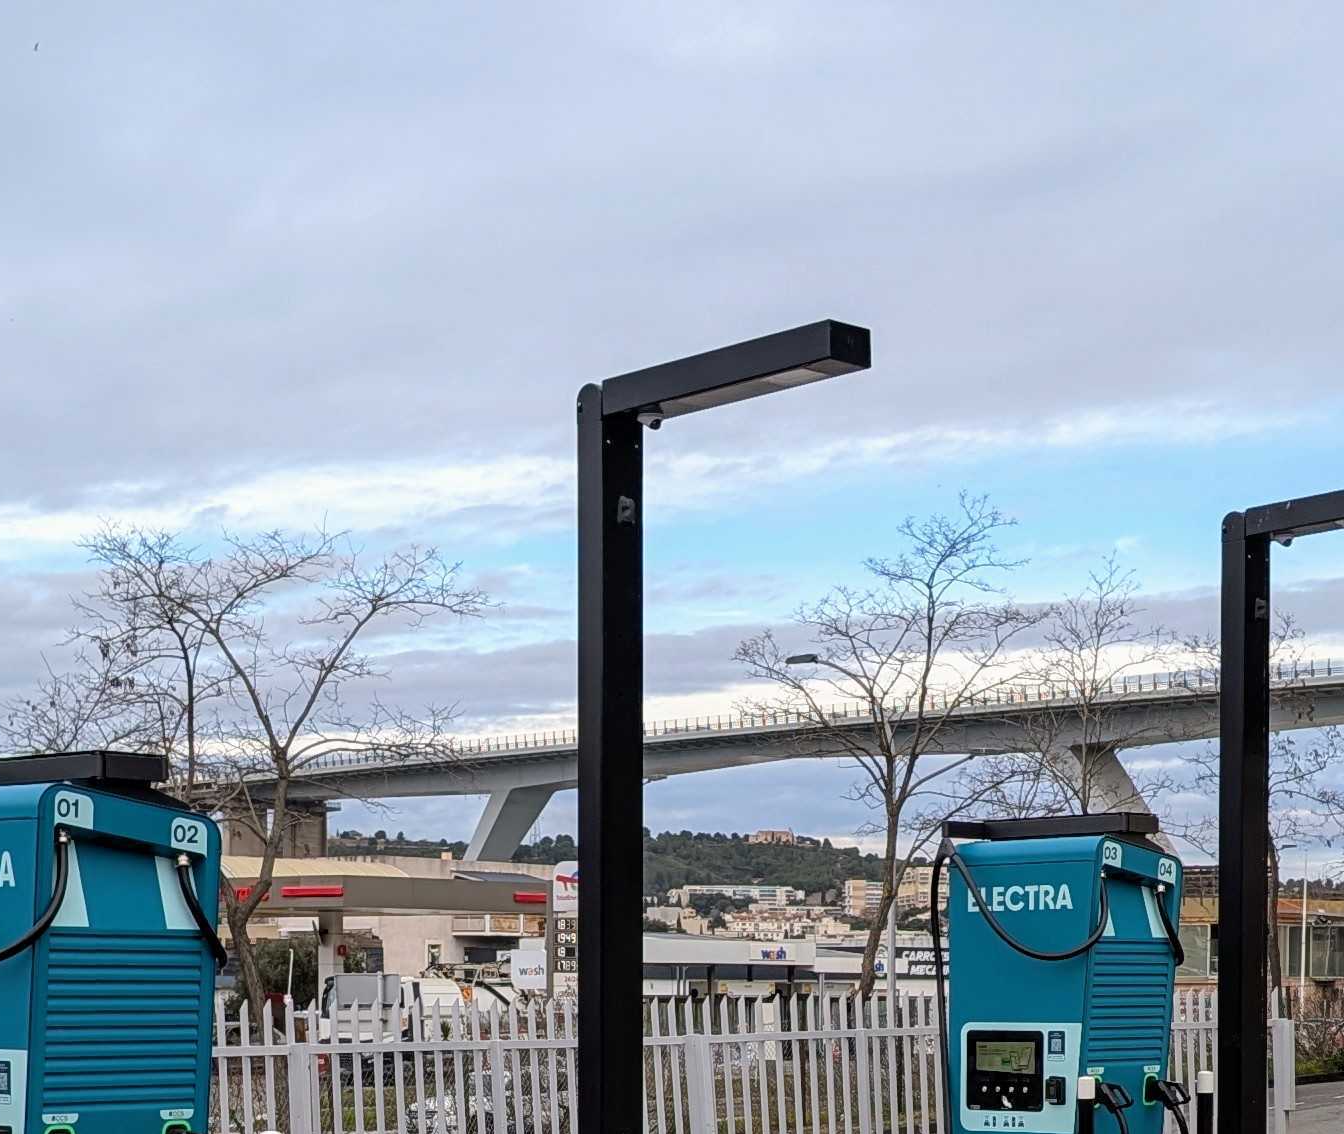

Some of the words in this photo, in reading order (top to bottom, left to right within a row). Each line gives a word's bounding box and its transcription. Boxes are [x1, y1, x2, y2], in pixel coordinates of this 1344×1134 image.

[57, 798, 80, 818] 01
[173, 824, 199, 844] 02
[1104, 846, 1118, 861] 03
[1159, 863, 1173, 877] 04
[518, 964, 544, 976] wash
